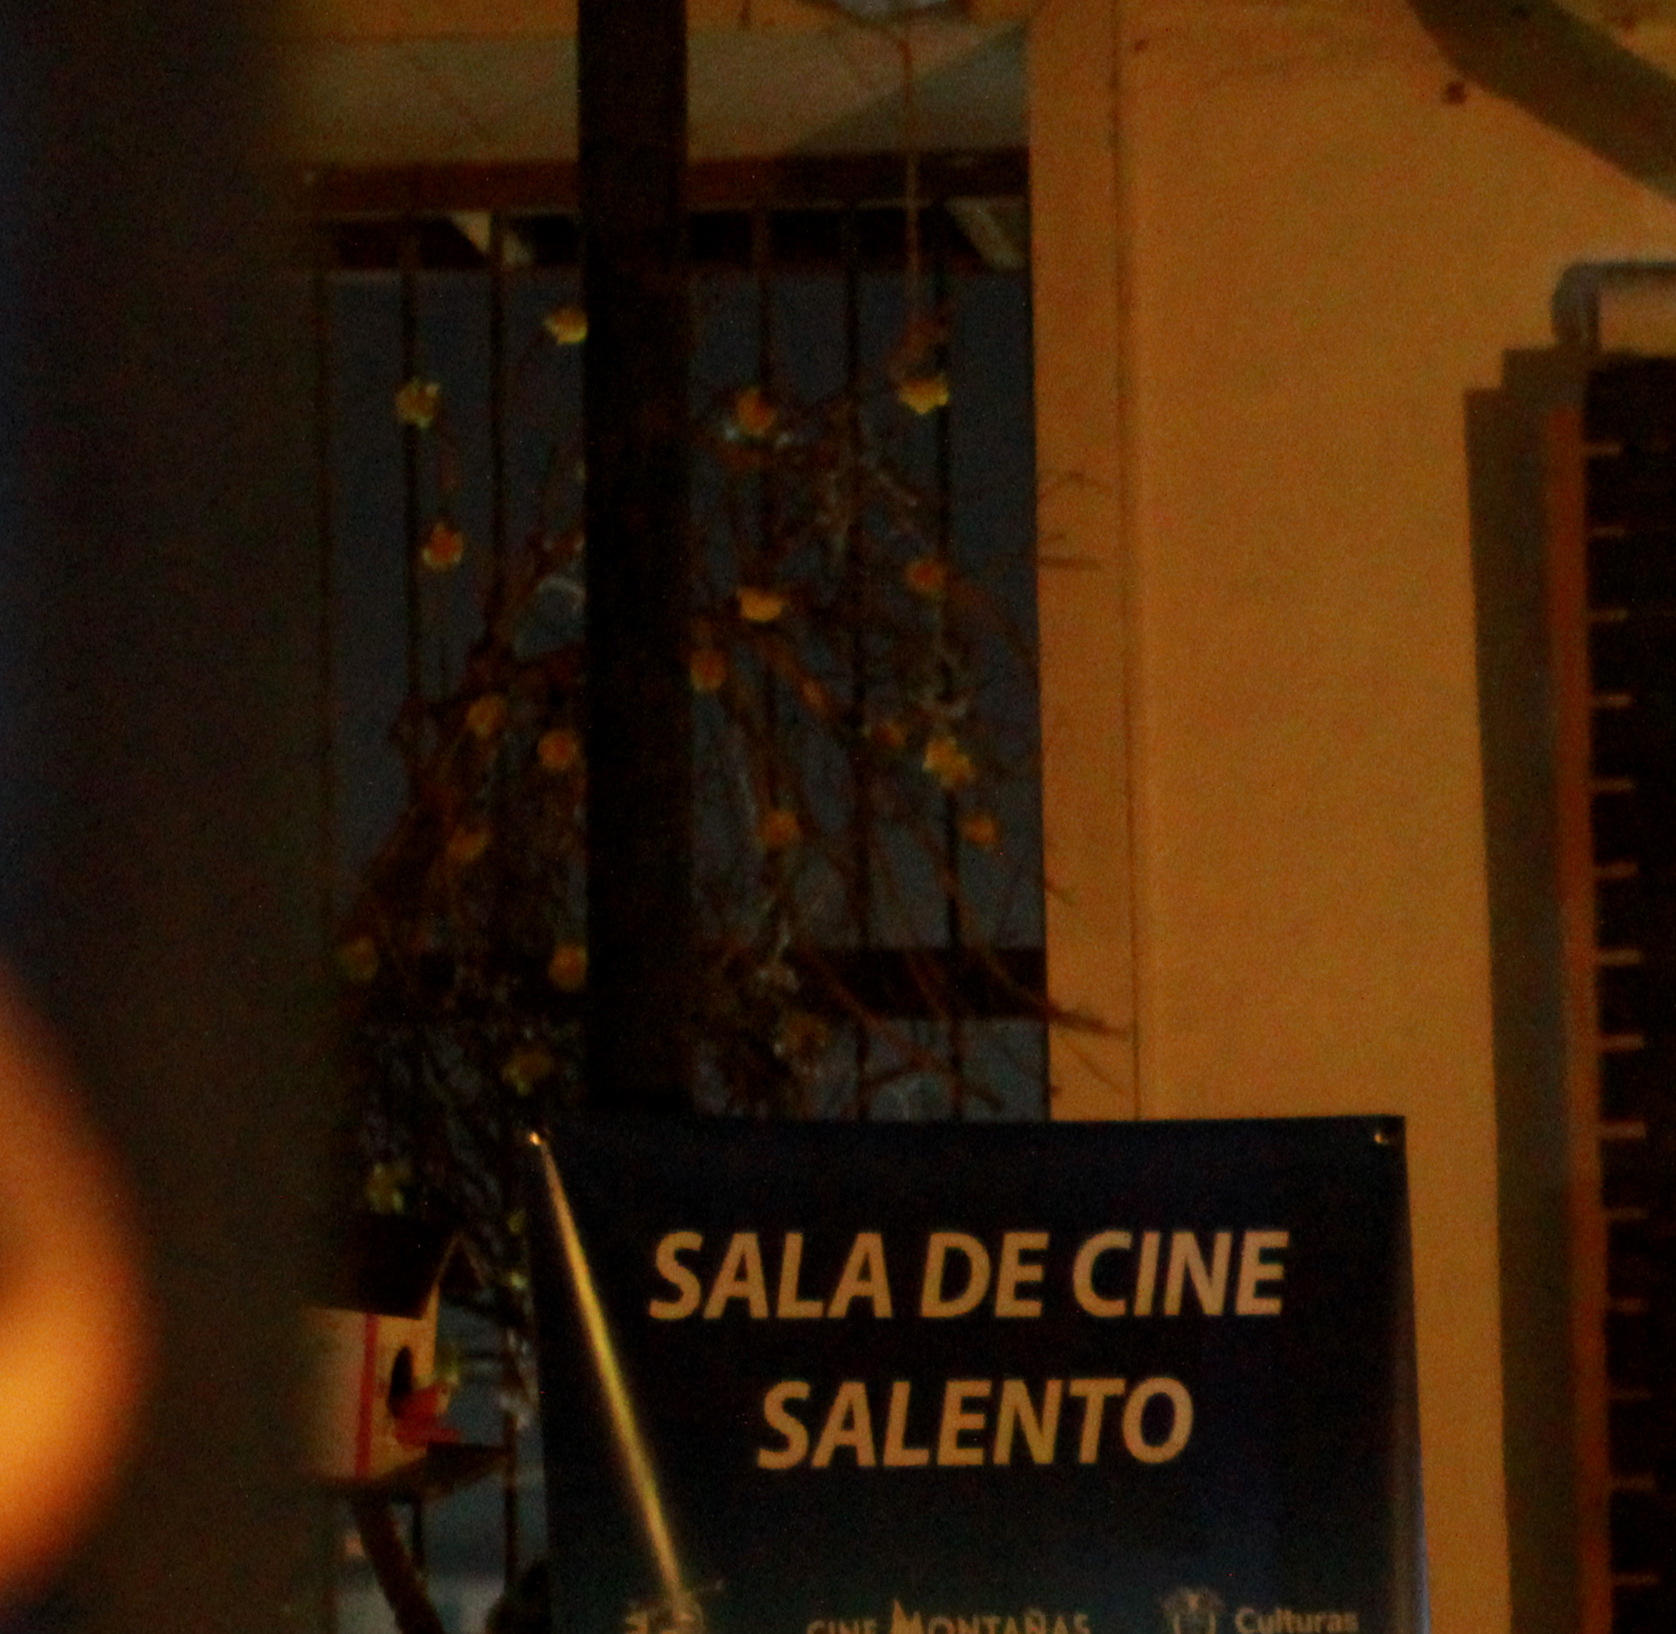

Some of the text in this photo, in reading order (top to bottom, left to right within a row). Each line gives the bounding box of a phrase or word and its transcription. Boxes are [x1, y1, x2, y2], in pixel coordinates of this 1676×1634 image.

[648, 1230, 1289, 1321] SALA DE CINE
[756, 1376, 1196, 1471] SALENTO
